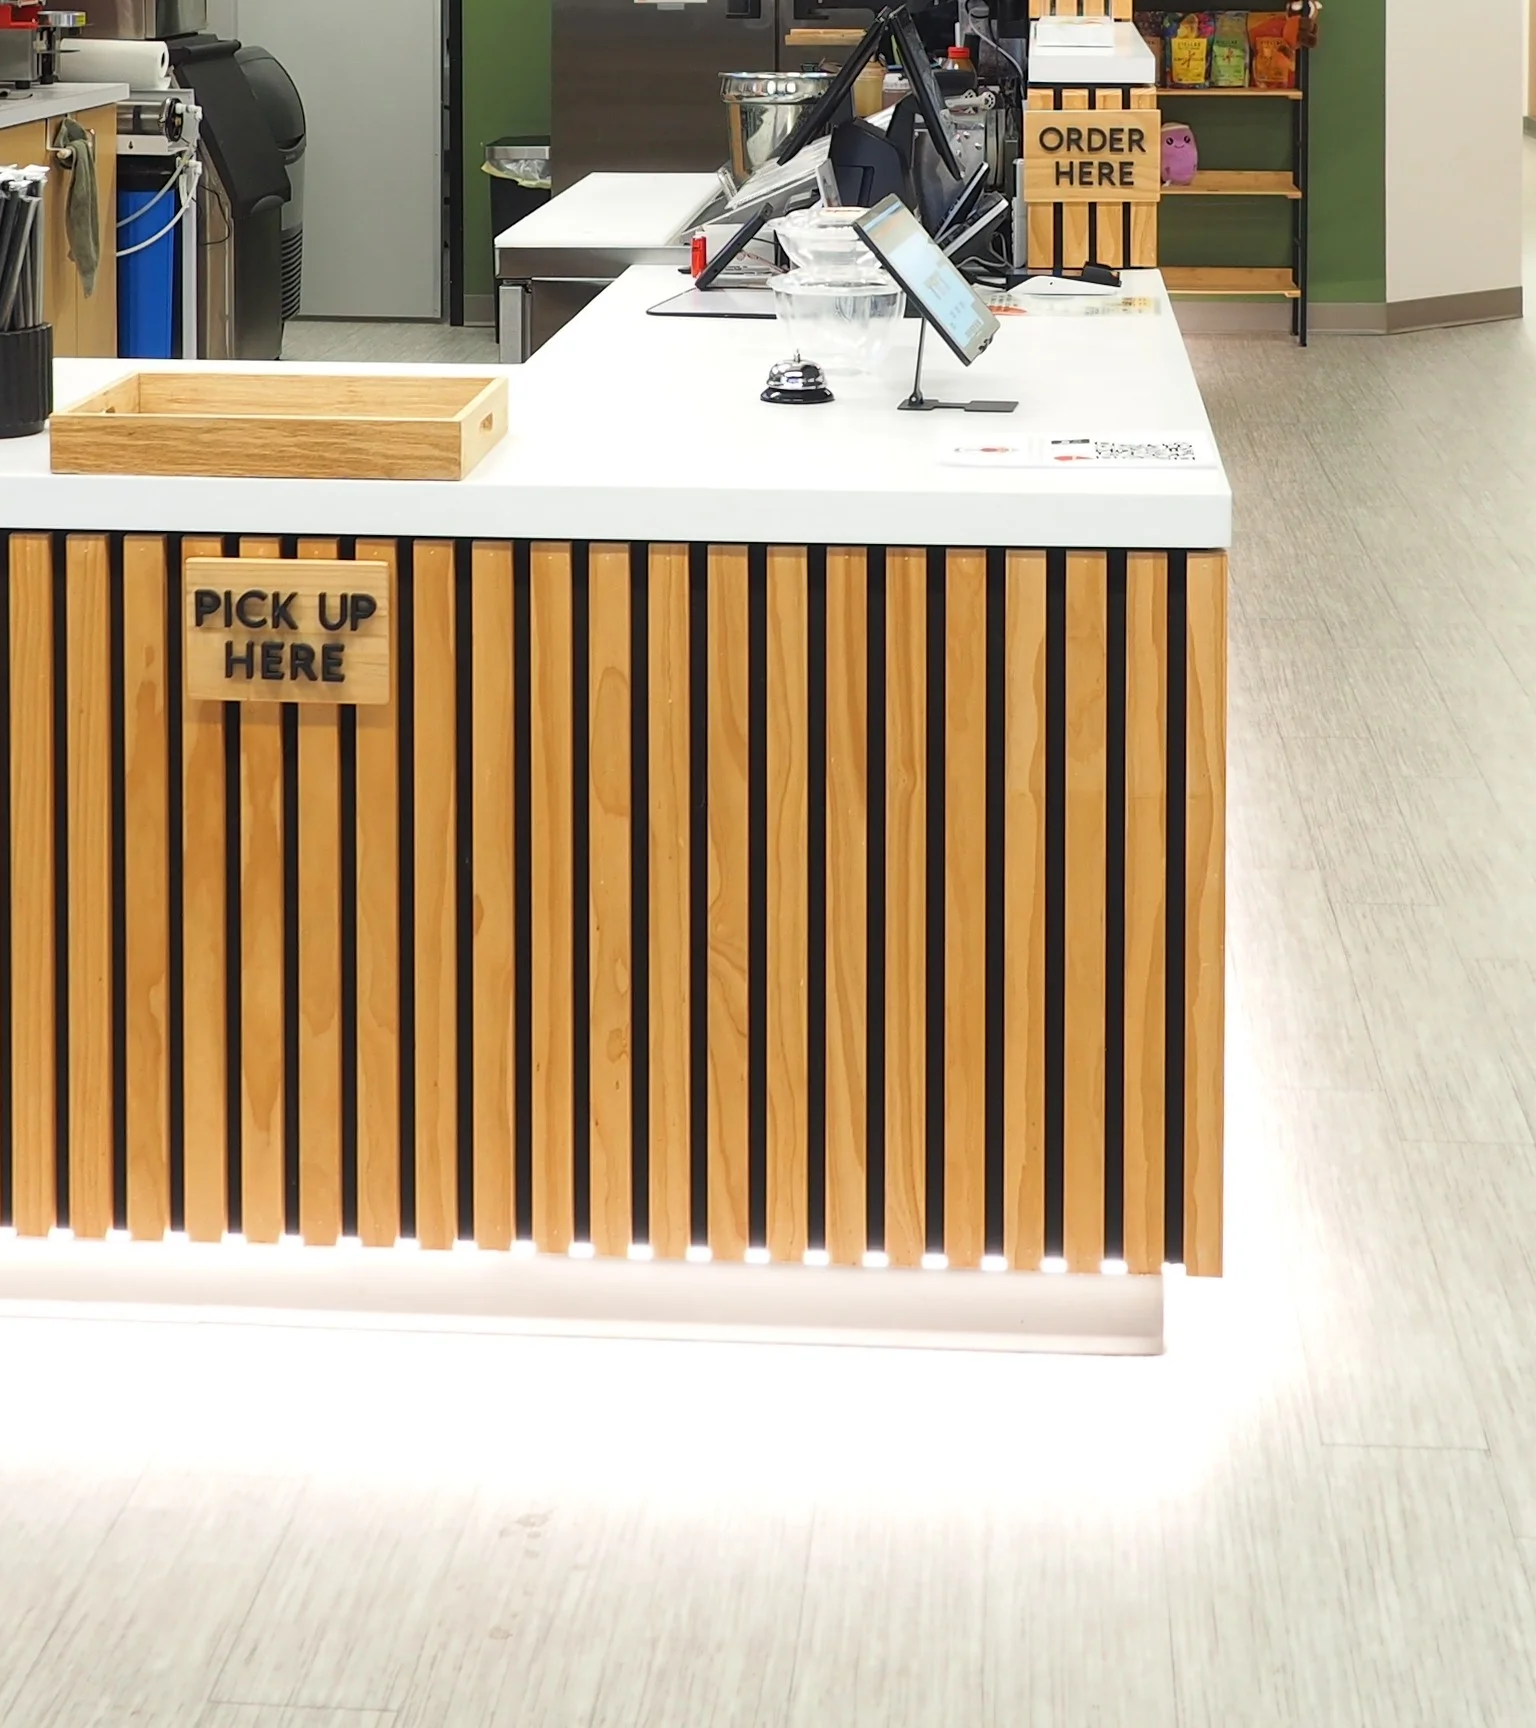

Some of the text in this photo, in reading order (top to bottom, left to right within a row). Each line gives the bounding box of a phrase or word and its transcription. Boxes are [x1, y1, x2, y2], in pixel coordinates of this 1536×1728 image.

[1039, 127, 1146, 152] ORDER
[1055, 161, 1134, 186] HERE
[194, 589, 377, 631] PICK UP
[224, 640, 345, 683] HERE
